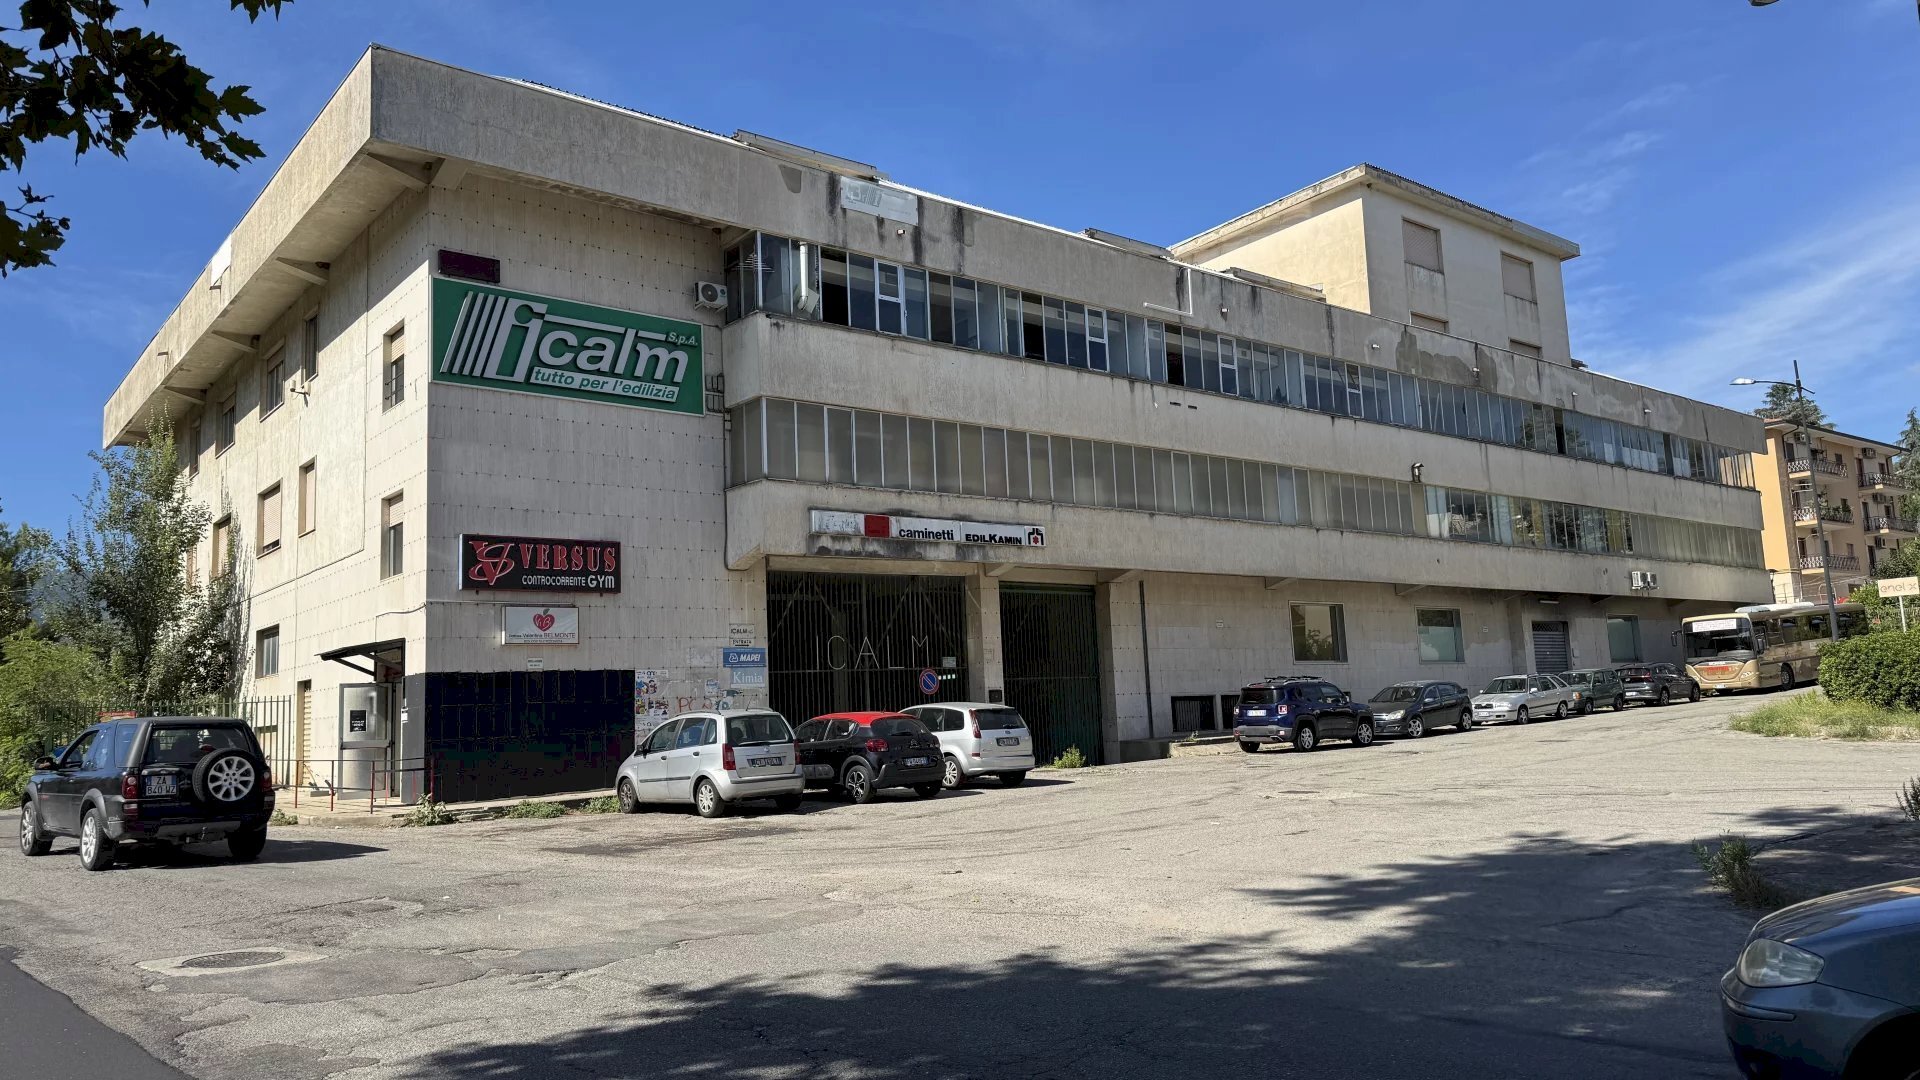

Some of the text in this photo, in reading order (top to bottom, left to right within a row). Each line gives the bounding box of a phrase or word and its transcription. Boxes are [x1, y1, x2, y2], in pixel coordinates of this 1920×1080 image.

[667, 331, 699, 346] S.p.A.
[535, 368, 677, 400] tutto per l'edilizia
[899, 528, 954, 541] caminetti
[519, 543, 616, 572] VERSUS
[587, 575, 615, 589] GYM
[739, 653, 761, 662] MAPEI
[816, 635, 930, 670] ICALM
[733, 671, 763, 684] Kimia
[157, 776, 167, 784] ZA
